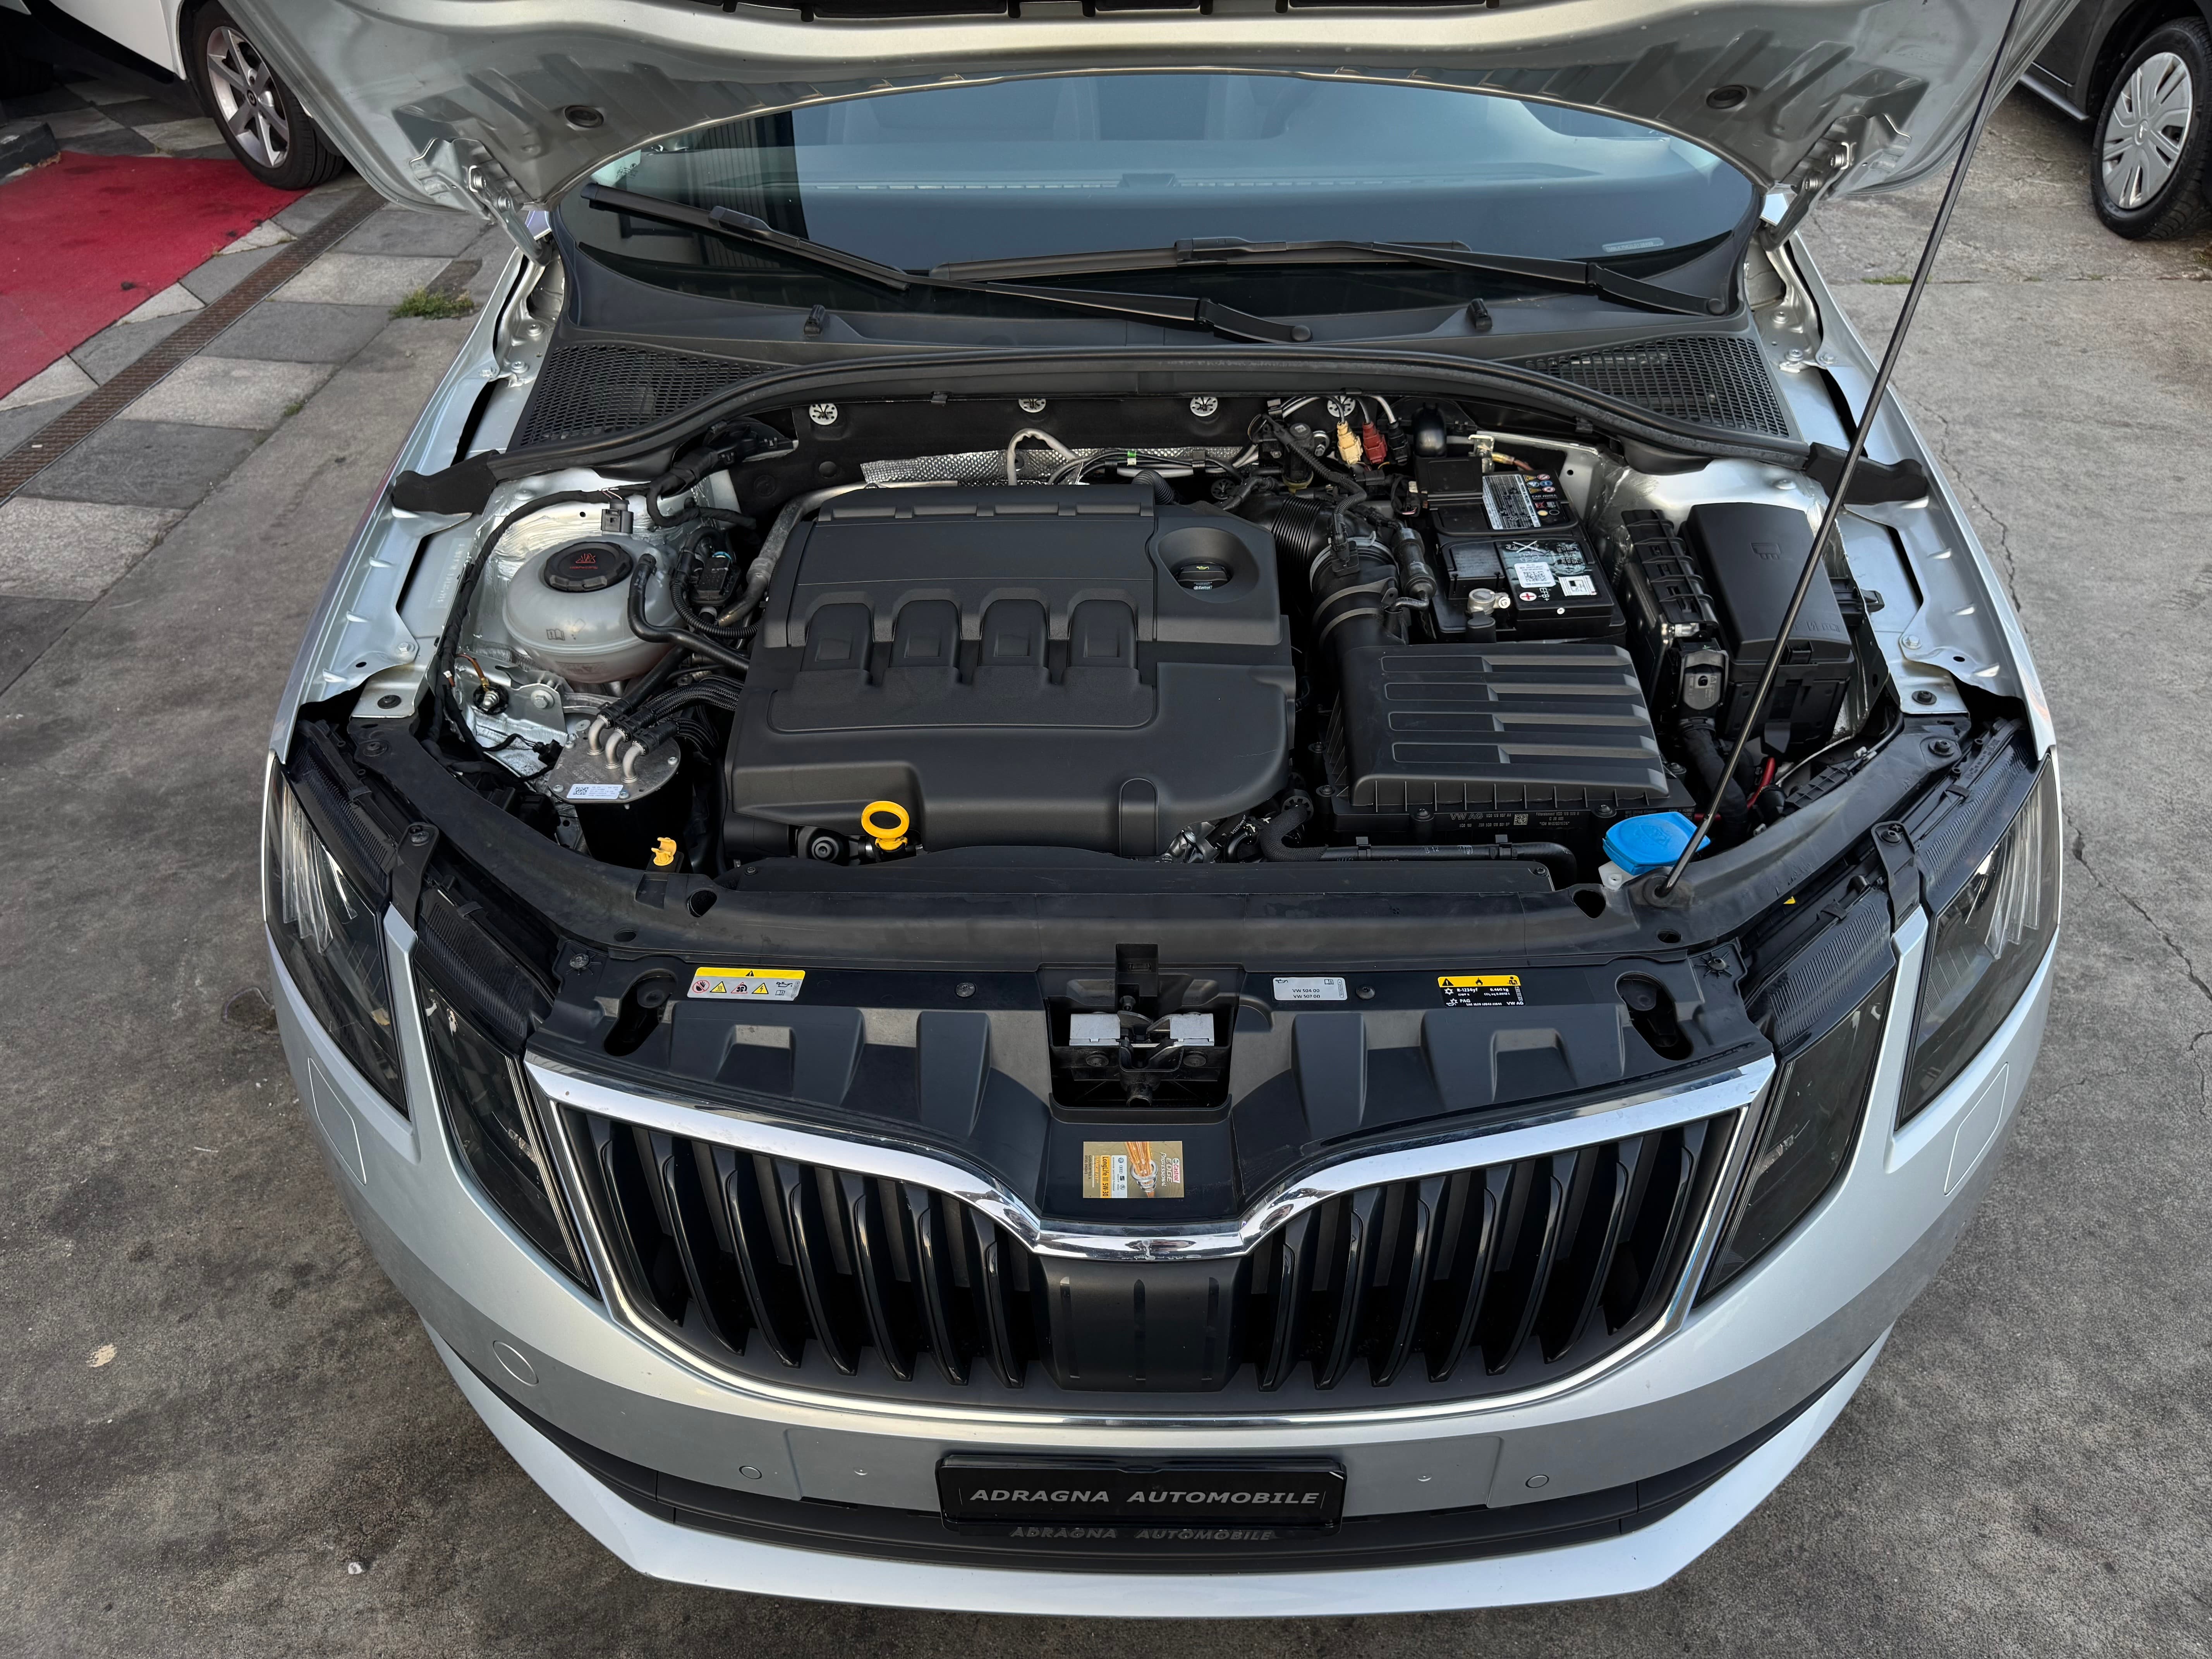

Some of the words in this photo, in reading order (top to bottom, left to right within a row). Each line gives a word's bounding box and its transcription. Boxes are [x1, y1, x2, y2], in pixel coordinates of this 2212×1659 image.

[1539, 587, 1549, 601] EFB+
[970, 1489, 1109, 1502] ADRAGNA
[1126, 1491, 1319, 1504] AUTOMOBILE
[1010, 1526, 1117, 1539] ADRAGNA
[1135, 1528, 1273, 1540] AUTOMOBILE
